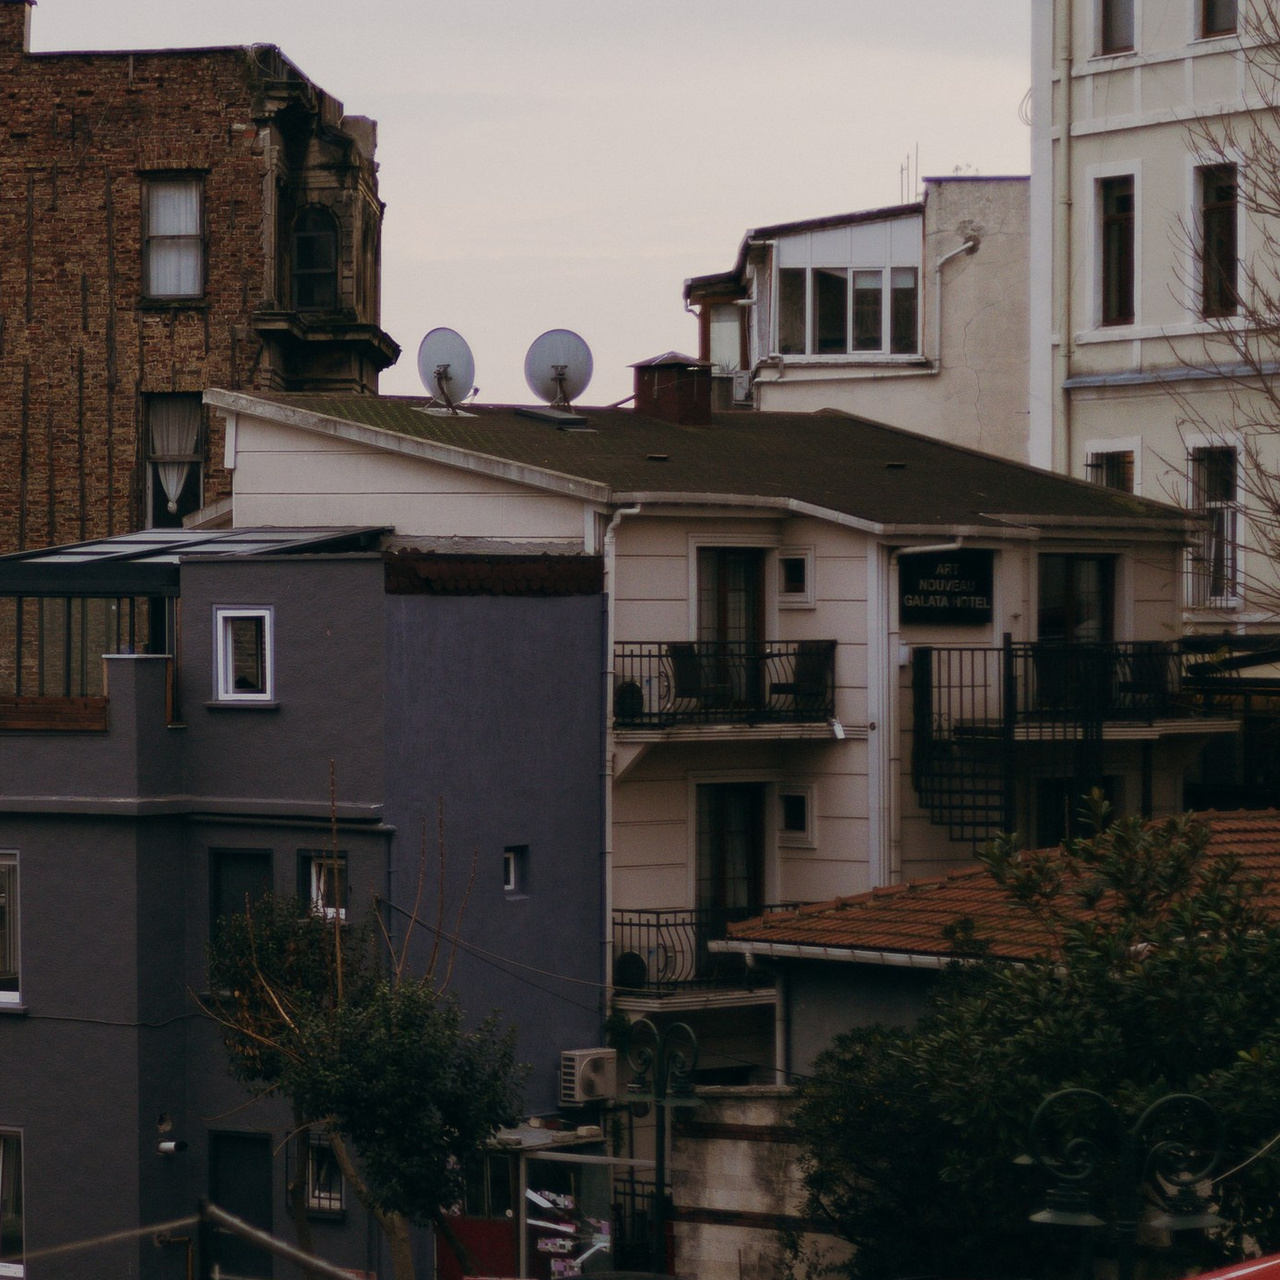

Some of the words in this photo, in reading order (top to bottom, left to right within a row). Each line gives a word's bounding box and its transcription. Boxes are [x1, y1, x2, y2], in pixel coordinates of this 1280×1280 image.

[935, 563, 960, 576] ART
[919, 578, 976, 592] NOUVEAU
[904, 594, 949, 608] GALATA
[952, 596, 991, 609] HOTEL
